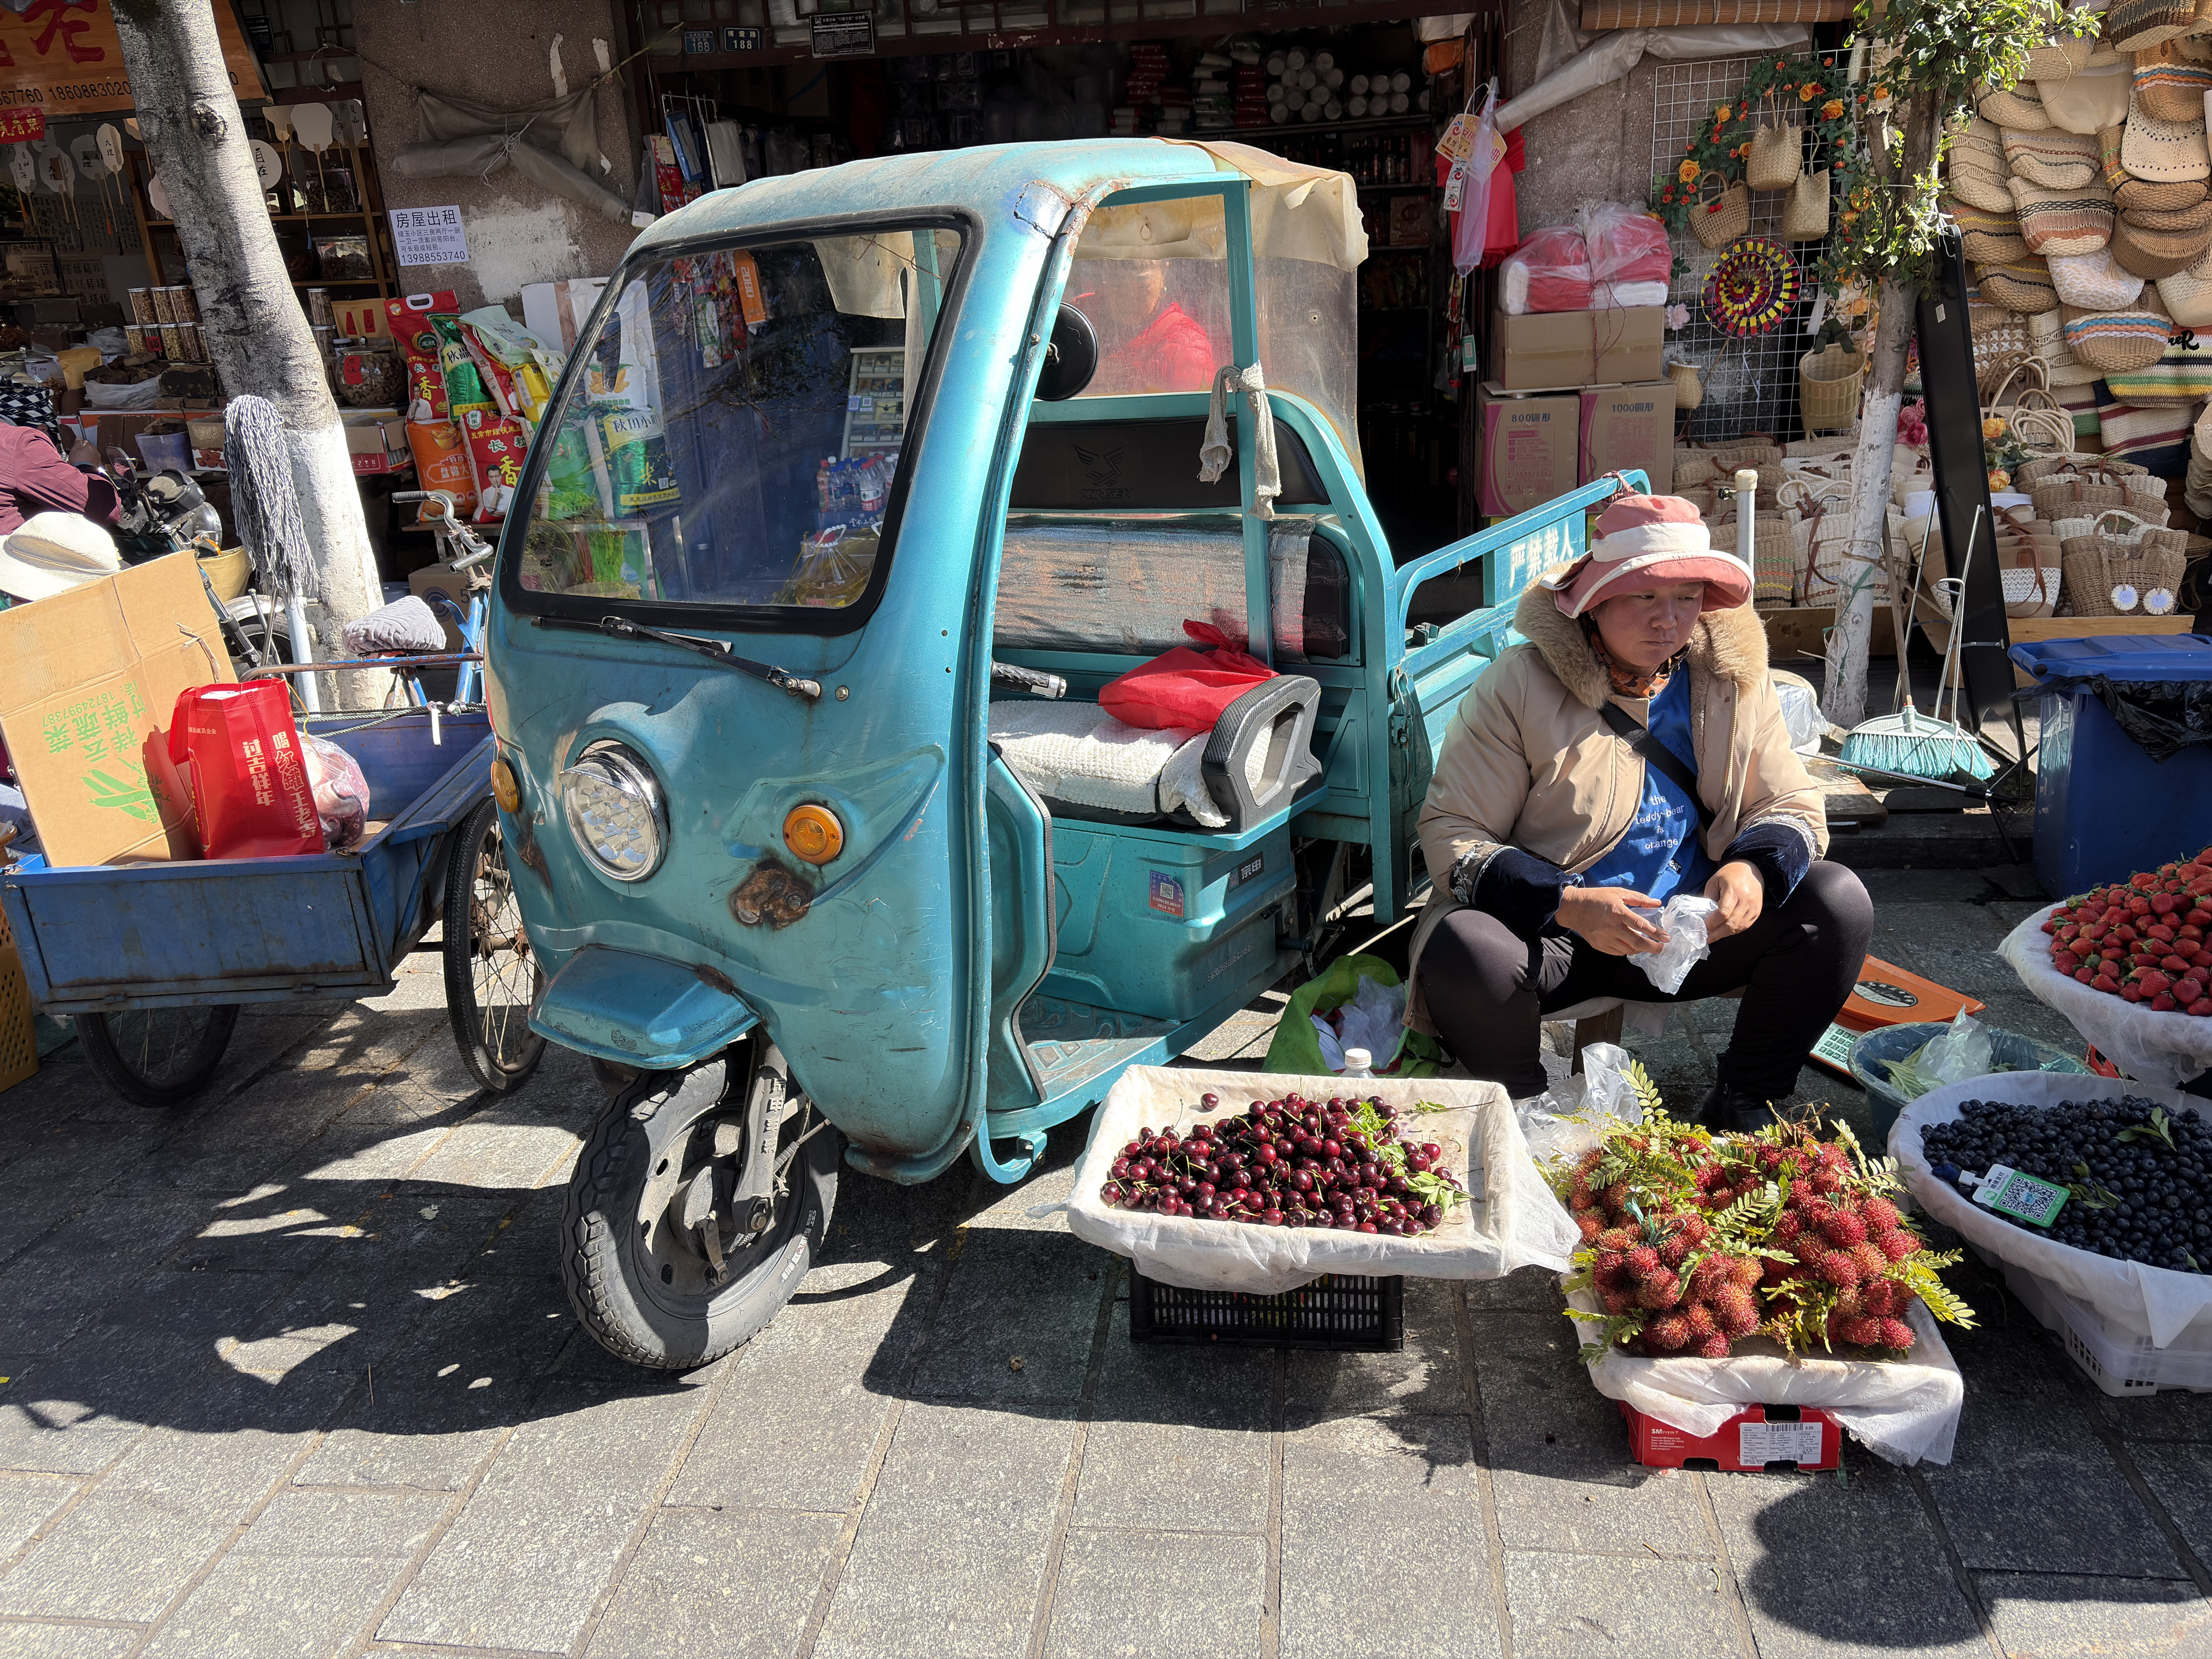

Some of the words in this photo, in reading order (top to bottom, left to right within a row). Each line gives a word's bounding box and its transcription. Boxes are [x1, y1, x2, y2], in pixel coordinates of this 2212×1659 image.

[692, 41, 709, 52] 188
[733, 40, 752, 49] 188
[105, 139, 114, 156] 大理
[255, 147, 268, 178] 自在
[397, 210, 457, 228] 房屋出租
[398, 227, 461, 237] 绿玉小区三房两厅一厨
[400, 244, 441, 252] 可长租或短租。
[401, 251, 465, 263] 13988553740
[419, 376, 438, 400] 香
[499, 455, 521, 487] 香
[1509, 519, 1574, 591] 严禁载人
[43, 691, 115, 727] 18724997387
[83, 726, 138, 763] 祥云
[242, 739, 275, 806] 过吉祥年
[272, 731, 316, 838] 喝红罐王老吉
[1650, 795, 1666, 805] the
[1666, 805, 1684, 818] bear
[1645, 838, 1679, 849] orange
[1241, 858, 1261, 880] 宗申
[1990, 1171, 2005, 1189] 微信支付
